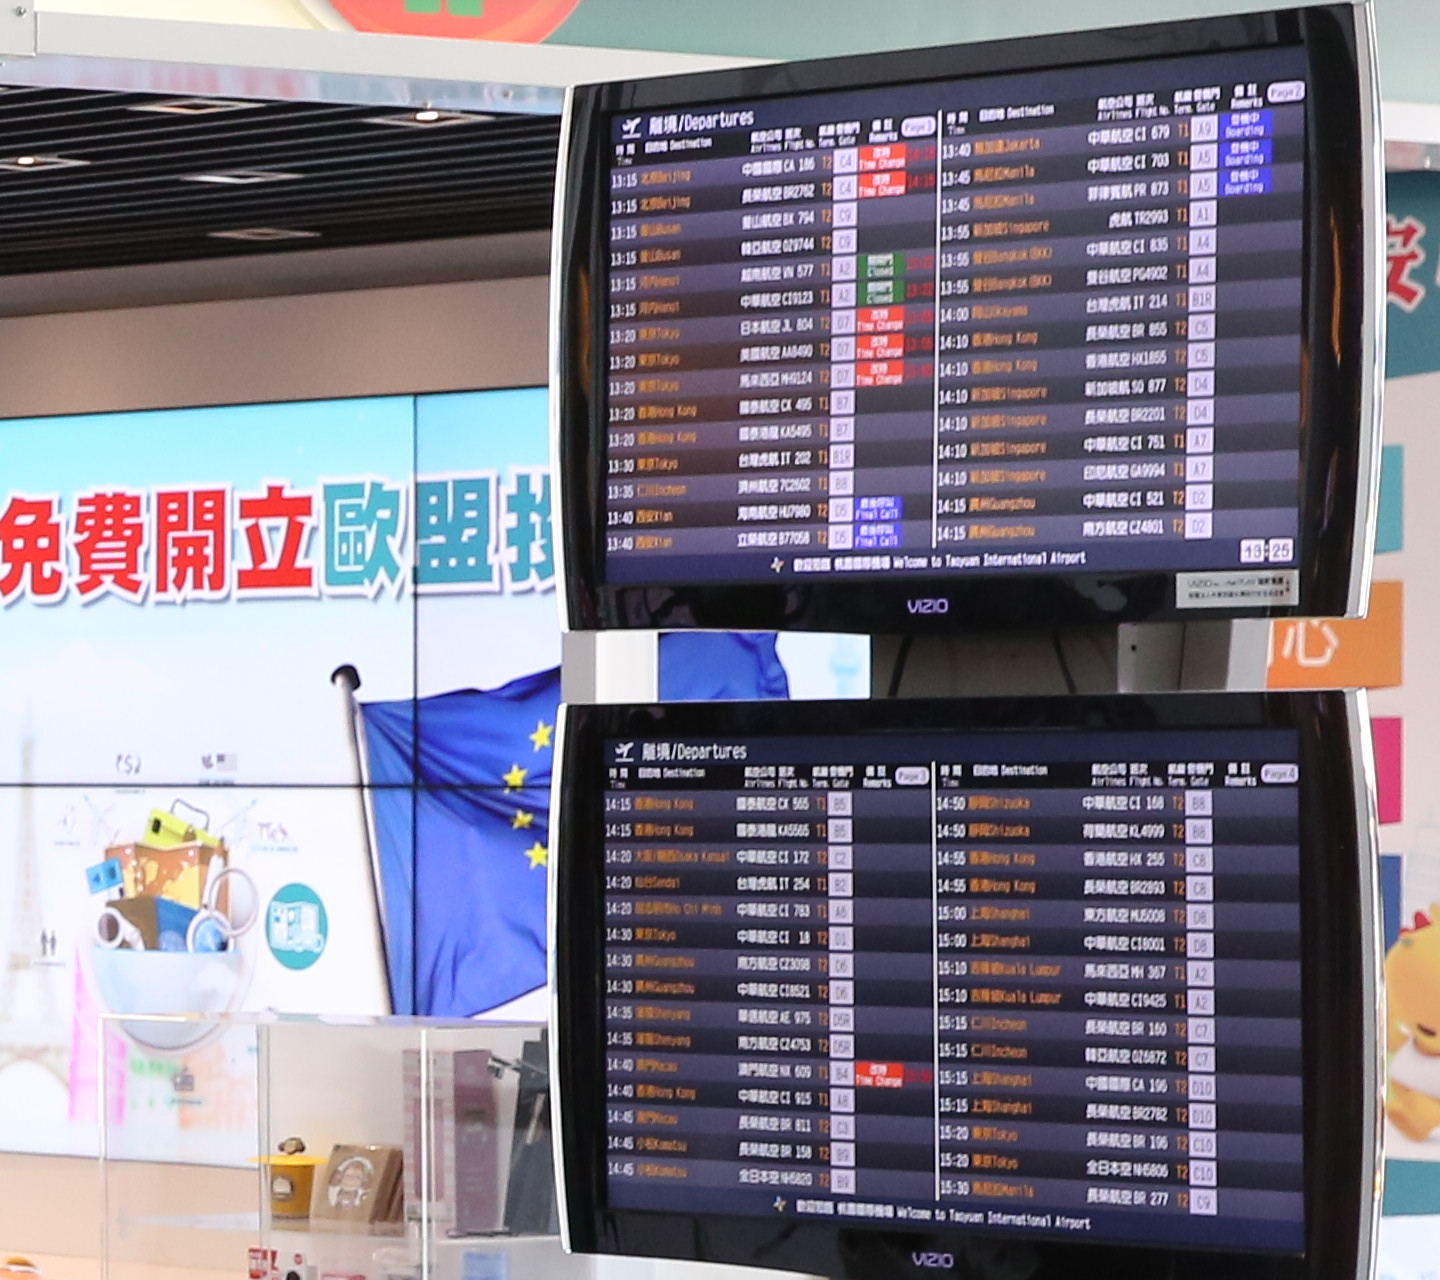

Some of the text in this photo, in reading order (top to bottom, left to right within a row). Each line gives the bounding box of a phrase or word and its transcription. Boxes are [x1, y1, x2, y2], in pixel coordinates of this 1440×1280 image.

[649, 110, 754, 134] 離境/Departures
[941, 143, 970, 159] 13:40
[611, 173, 637, 188] 13:15
[941, 170, 970, 186] 13:45
[610, 199, 637, 214] 13:15
[940, 197, 970, 213] 13:45
[940, 225, 969, 240] 13:55
[940, 252, 969, 268] 13:55
[610, 277, 636, 292] 13:15
[940, 279, 969, 295] 13:55
[940, 307, 969, 322] 14:00
[609, 329, 636, 344] 13:20
[939, 334, 968, 349] 14:10
[939, 361, 968, 376] 14:10
[609, 381, 635, 395] 13:20
[939, 389, 968, 404] 14:10
[939, 416, 968, 431] 14:10
[609, 433, 635, 447] 13:20
[938, 443, 968, 458] 14:10
[608, 459, 635, 473] 13:30
[938, 471, 967, 485] 14:10
[608, 485, 634, 499] 13:35
[938, 498, 967, 513] 14:15
[608, 511, 634, 525] 13:40
[938, 525, 967, 540] 14:15
[1244, 540, 1291, 559] 13:25
[893, 551, 1086, 569] Welcome to Taoyuan International Airport
[907, 598, 949, 615] VIZIO
[642, 741, 747, 760] 離境/Departures
[605, 797, 631, 810] 14:15
[937, 796, 966, 810] 14:50
[937, 823, 966, 837] 14:50
[606, 849, 632, 862] 14:20
[937, 851, 966, 865] 14:55
[937, 878, 967, 892] 14:55
[606, 901, 632, 914] 14:20
[938, 906, 967, 920] 15:00
[606, 927, 633, 940] 14:30
[938, 933, 967, 947] 15:00
[938, 961, 967, 975] 15:10
[607, 979, 633, 993] 14:30
[938, 988, 968, 1002] 15:10
[607, 1005, 633, 1019] 14:35
[939, 1016, 968, 1030] 15:15
[607, 1031, 634, 1045] 14:35
[939, 1043, 968, 1057] 15:15
[608, 1057, 634, 1071] 14:40
[939, 1070, 969, 1085] 15:15
[608, 1083, 634, 1097] 14:40
[940, 1098, 969, 1113] 15:15
[608, 1109, 634, 1123] 14:45
[940, 1125, 969, 1140] 15:20
[940, 1153, 969, 1168] 15:20
[609, 1161, 635, 1176] 14:45
[940, 1180, 970, 1195] 15:30
[896, 1206, 1090, 1232] Welcome to Taoyuan International Airport
[911, 1251, 954, 1269] VIZIO
